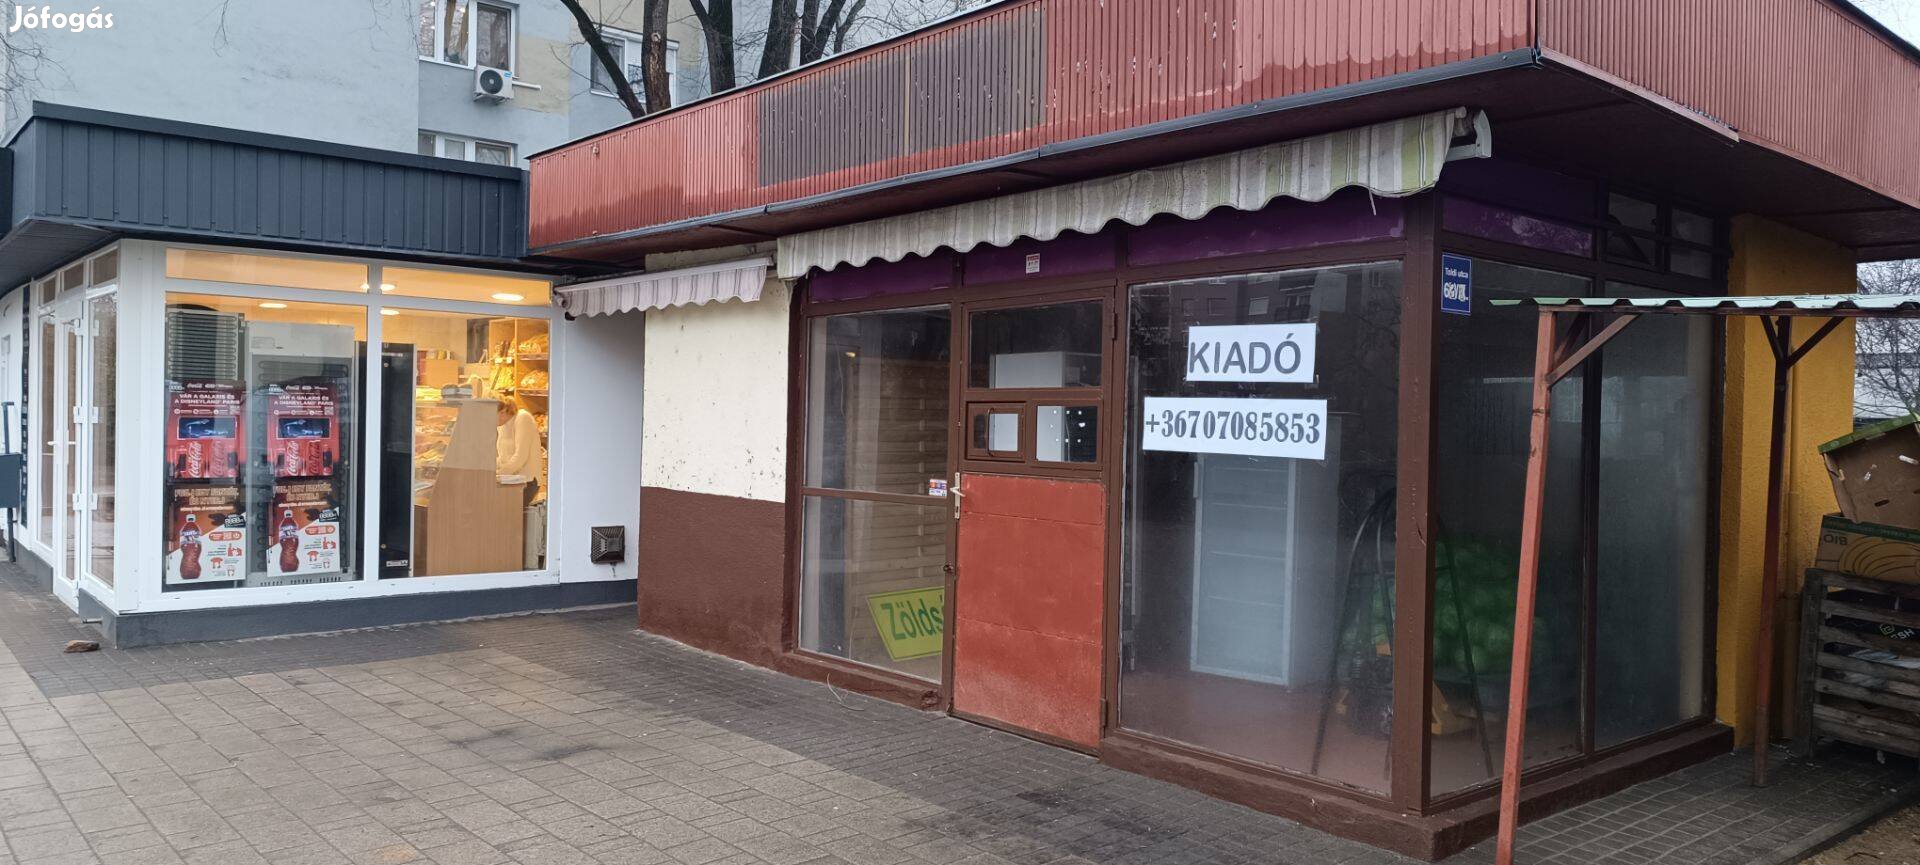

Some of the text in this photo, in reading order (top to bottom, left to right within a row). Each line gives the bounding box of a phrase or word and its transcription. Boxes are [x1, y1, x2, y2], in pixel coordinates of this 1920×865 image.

[1188, 332, 1302, 375] KIADÓ
[1145, 409, 1321, 444] +36707085853
[1823, 533, 1848, 546] BIO
[880, 595, 944, 640] Zölds
